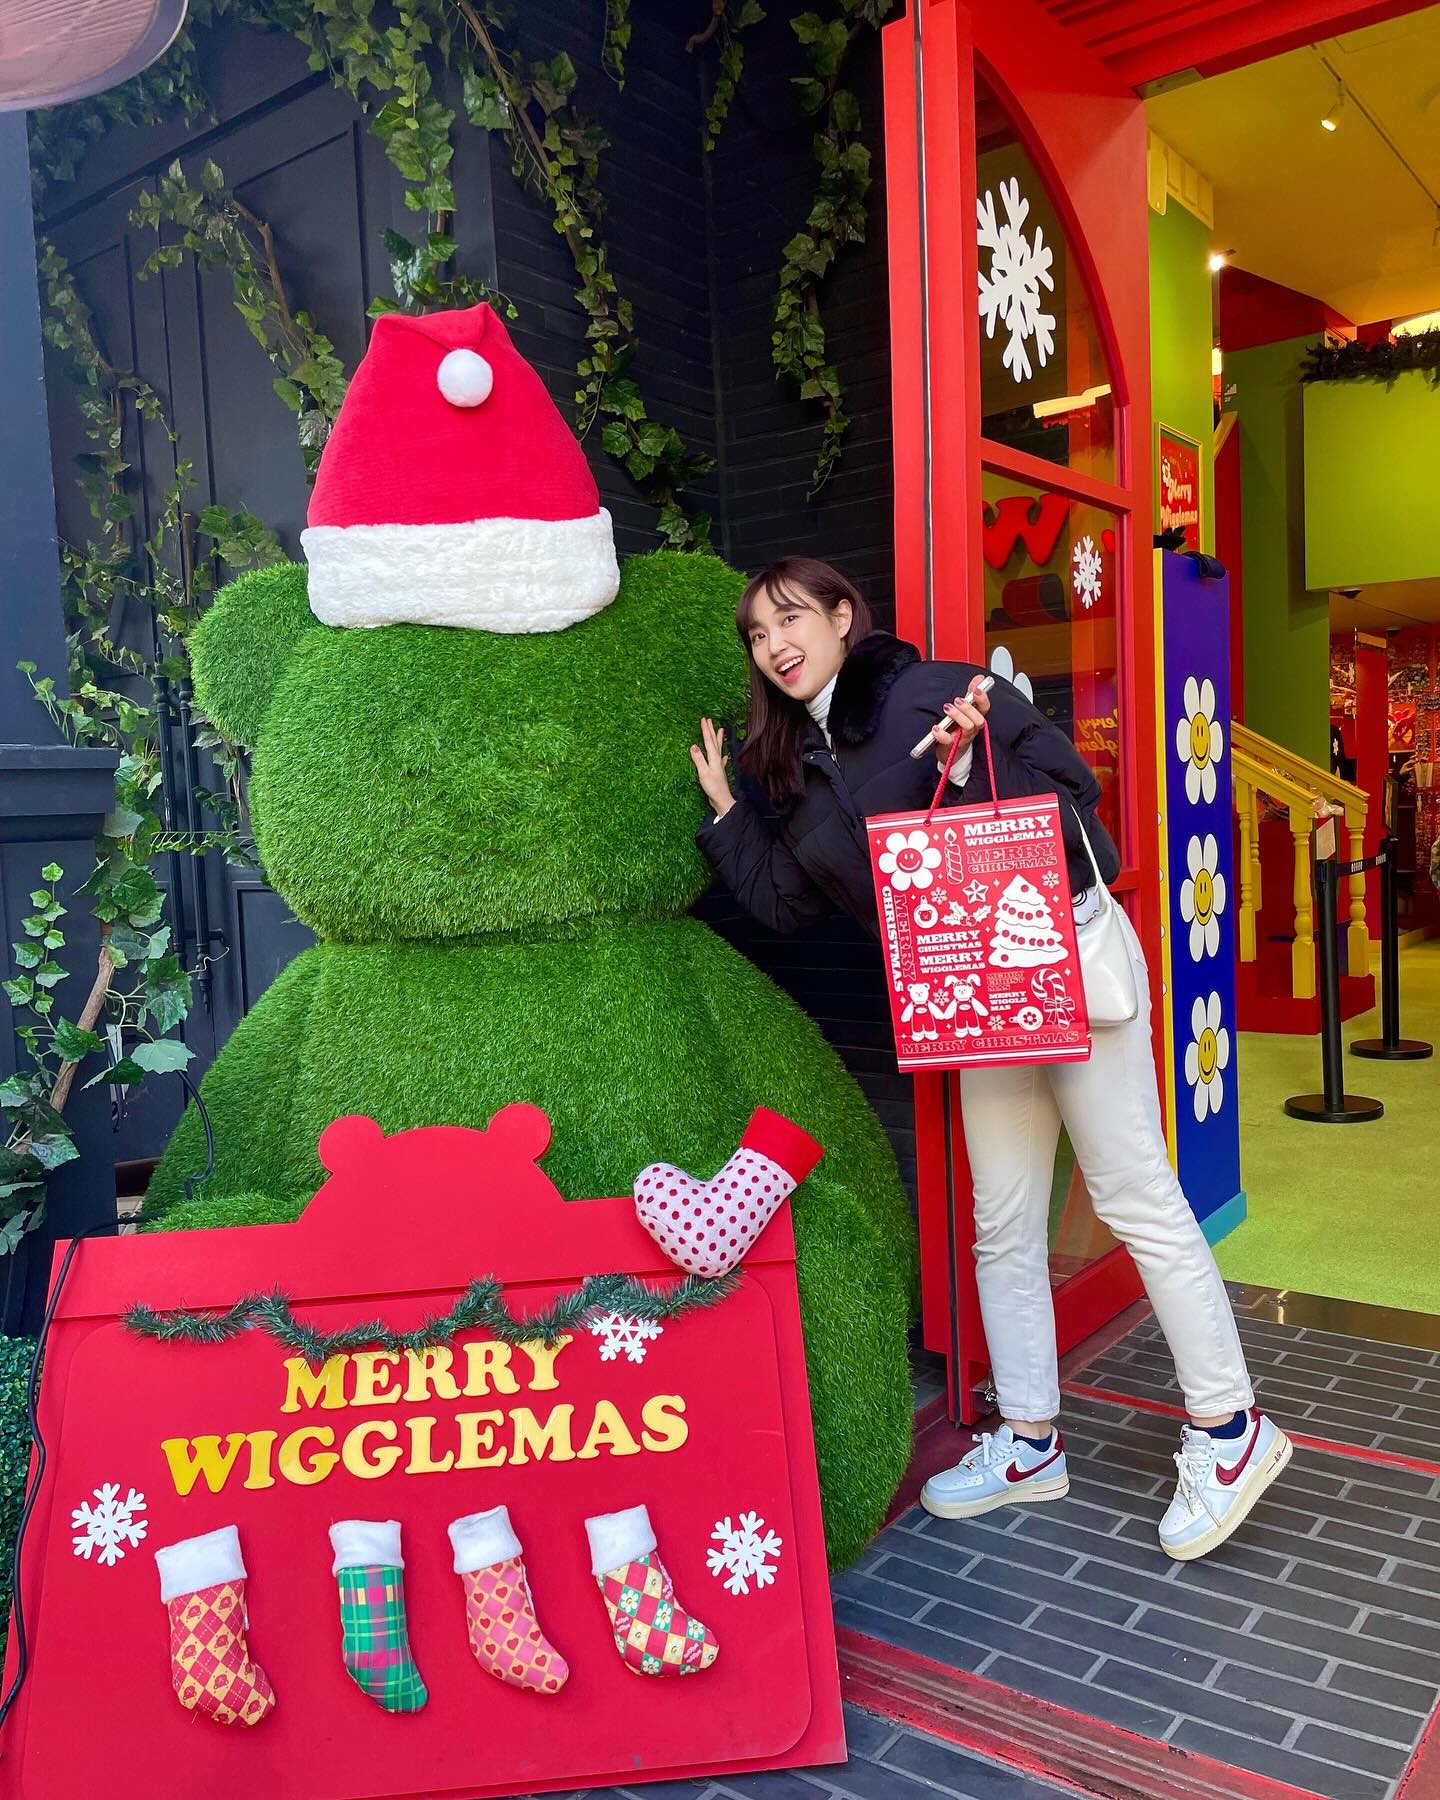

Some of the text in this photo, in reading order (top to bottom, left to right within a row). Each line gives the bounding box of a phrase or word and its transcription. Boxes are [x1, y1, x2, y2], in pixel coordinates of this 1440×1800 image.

[962, 815, 1052, 837] MERRY
[964, 829, 1055, 847] WIGGLEMAS
[966, 842, 1056, 865] MERRY
[968, 856, 1058, 874] CHRISTMAS
[882, 885, 904, 992] CHRISTMAS
[893, 894, 916, 981] MERRY
[916, 930, 980, 945] MERRY
[917, 941, 982, 953] CHRISTMAS
[918, 951, 984, 966] MERRY
[920, 962, 986, 974] WIGGLEMAS
[989, 990, 1026, 999] MERRY
[990, 997, 1028, 1005] WIGGLE
[902, 1031, 1079, 1055] MERRY CHRISTMAS
[280, 1335, 573, 1414] MERRY
[161, 1395, 690, 1496] WIGGLEMAS
